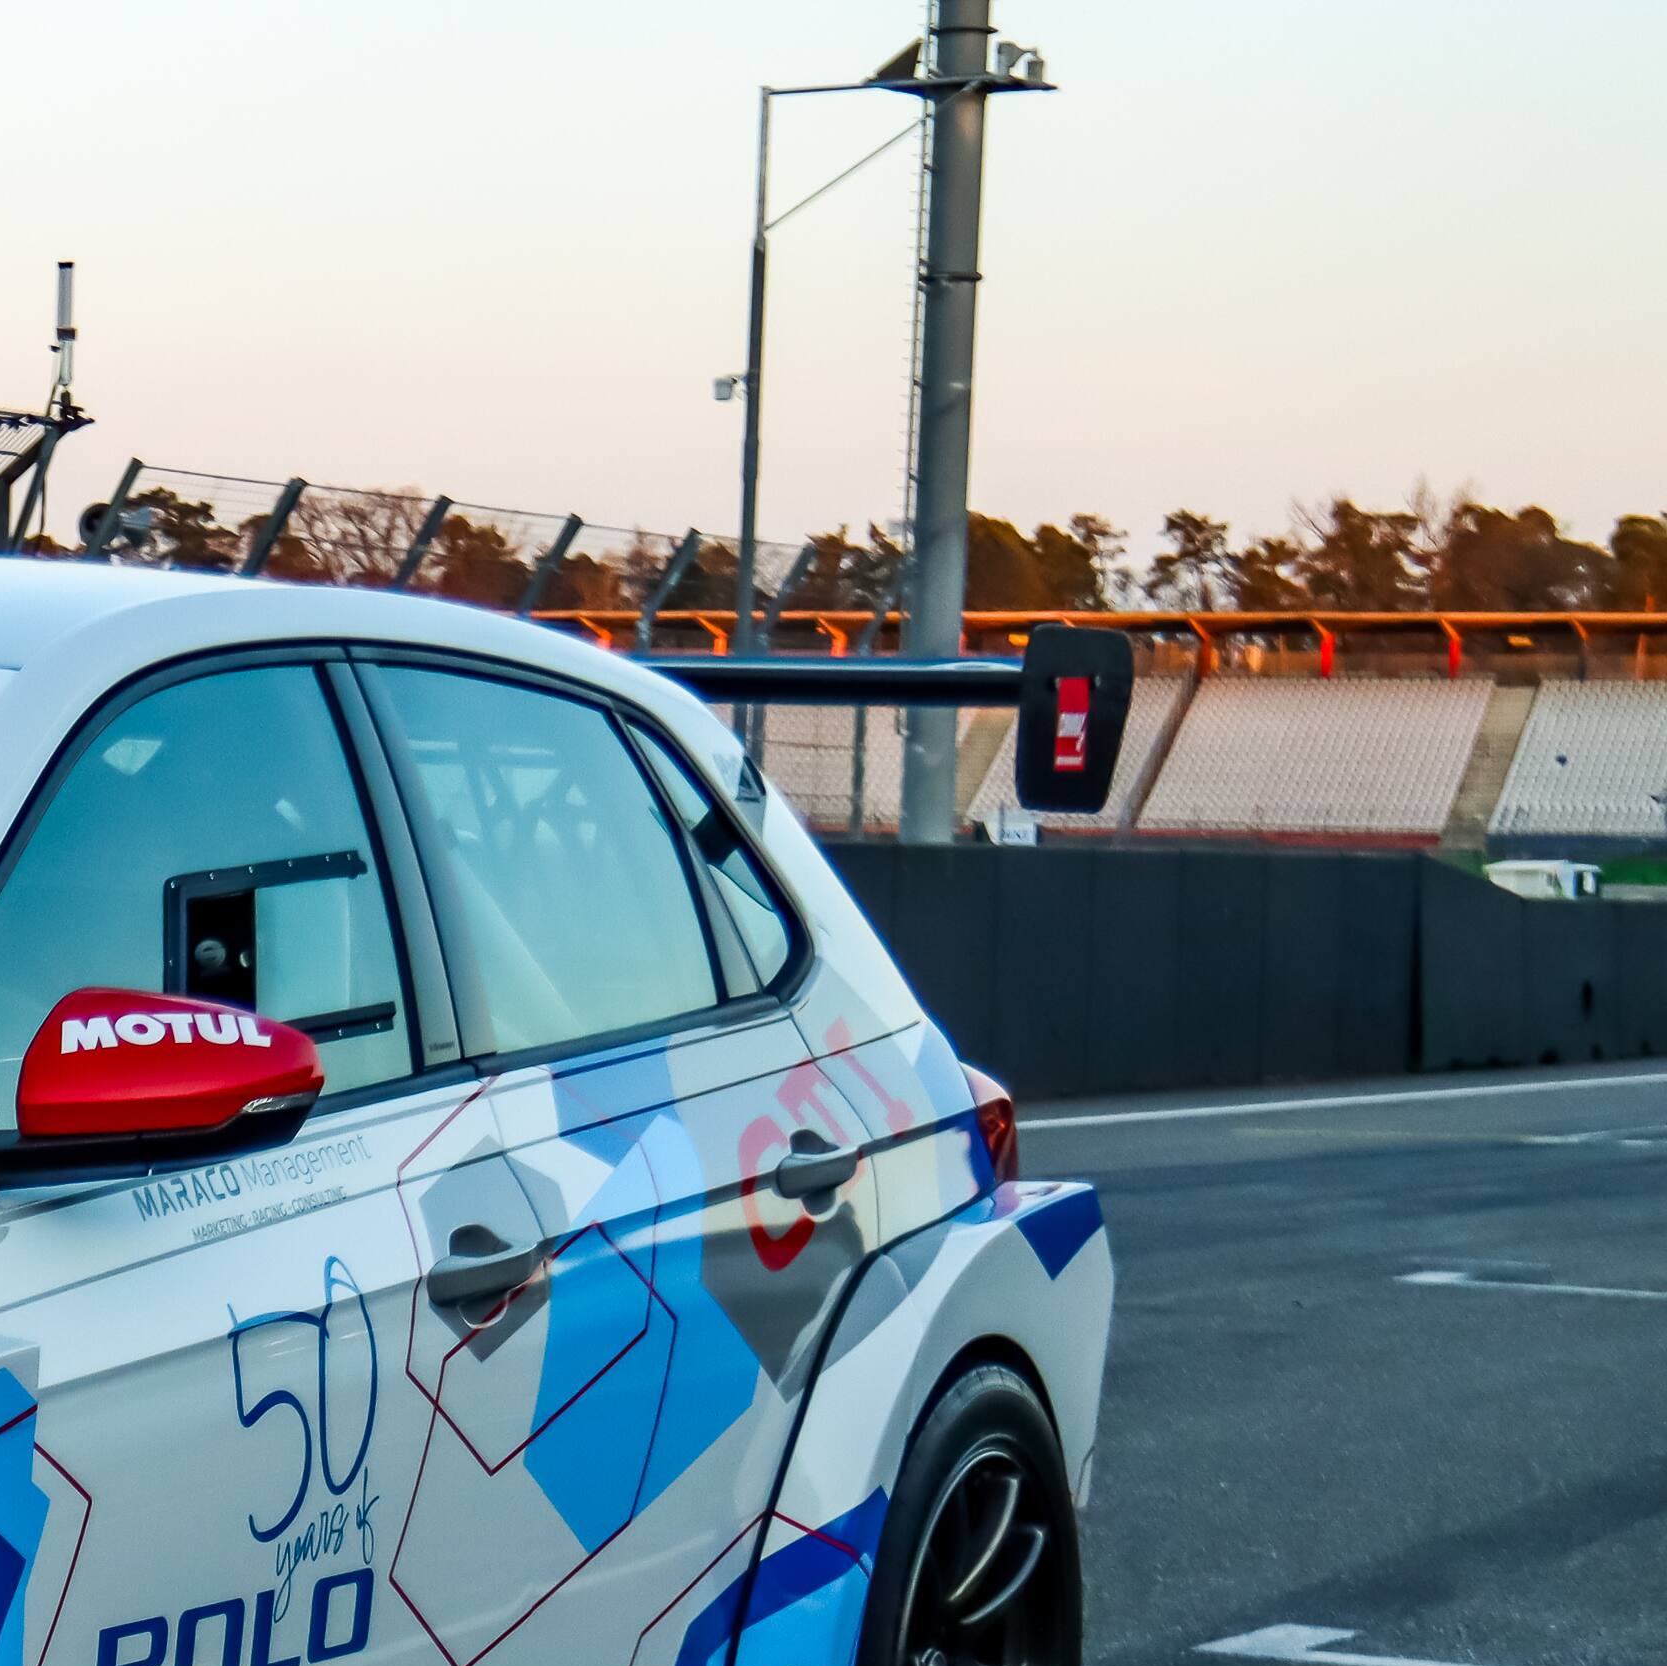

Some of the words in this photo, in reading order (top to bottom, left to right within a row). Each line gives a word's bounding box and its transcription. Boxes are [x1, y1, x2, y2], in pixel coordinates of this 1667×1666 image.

[60, 1013, 272, 1055] MOTUL
[132, 1163, 241, 1222] MARACO
[239, 1134, 372, 1192] Management
[191, 1213, 247, 1242] MARKETING
[251, 1202, 287, 1226] RACING
[291, 1185, 348, 1215] CONSULTING
[227, 1255, 378, 1542] 50
[274, 1503, 349, 1623] years
[355, 1466, 380, 1565] of
